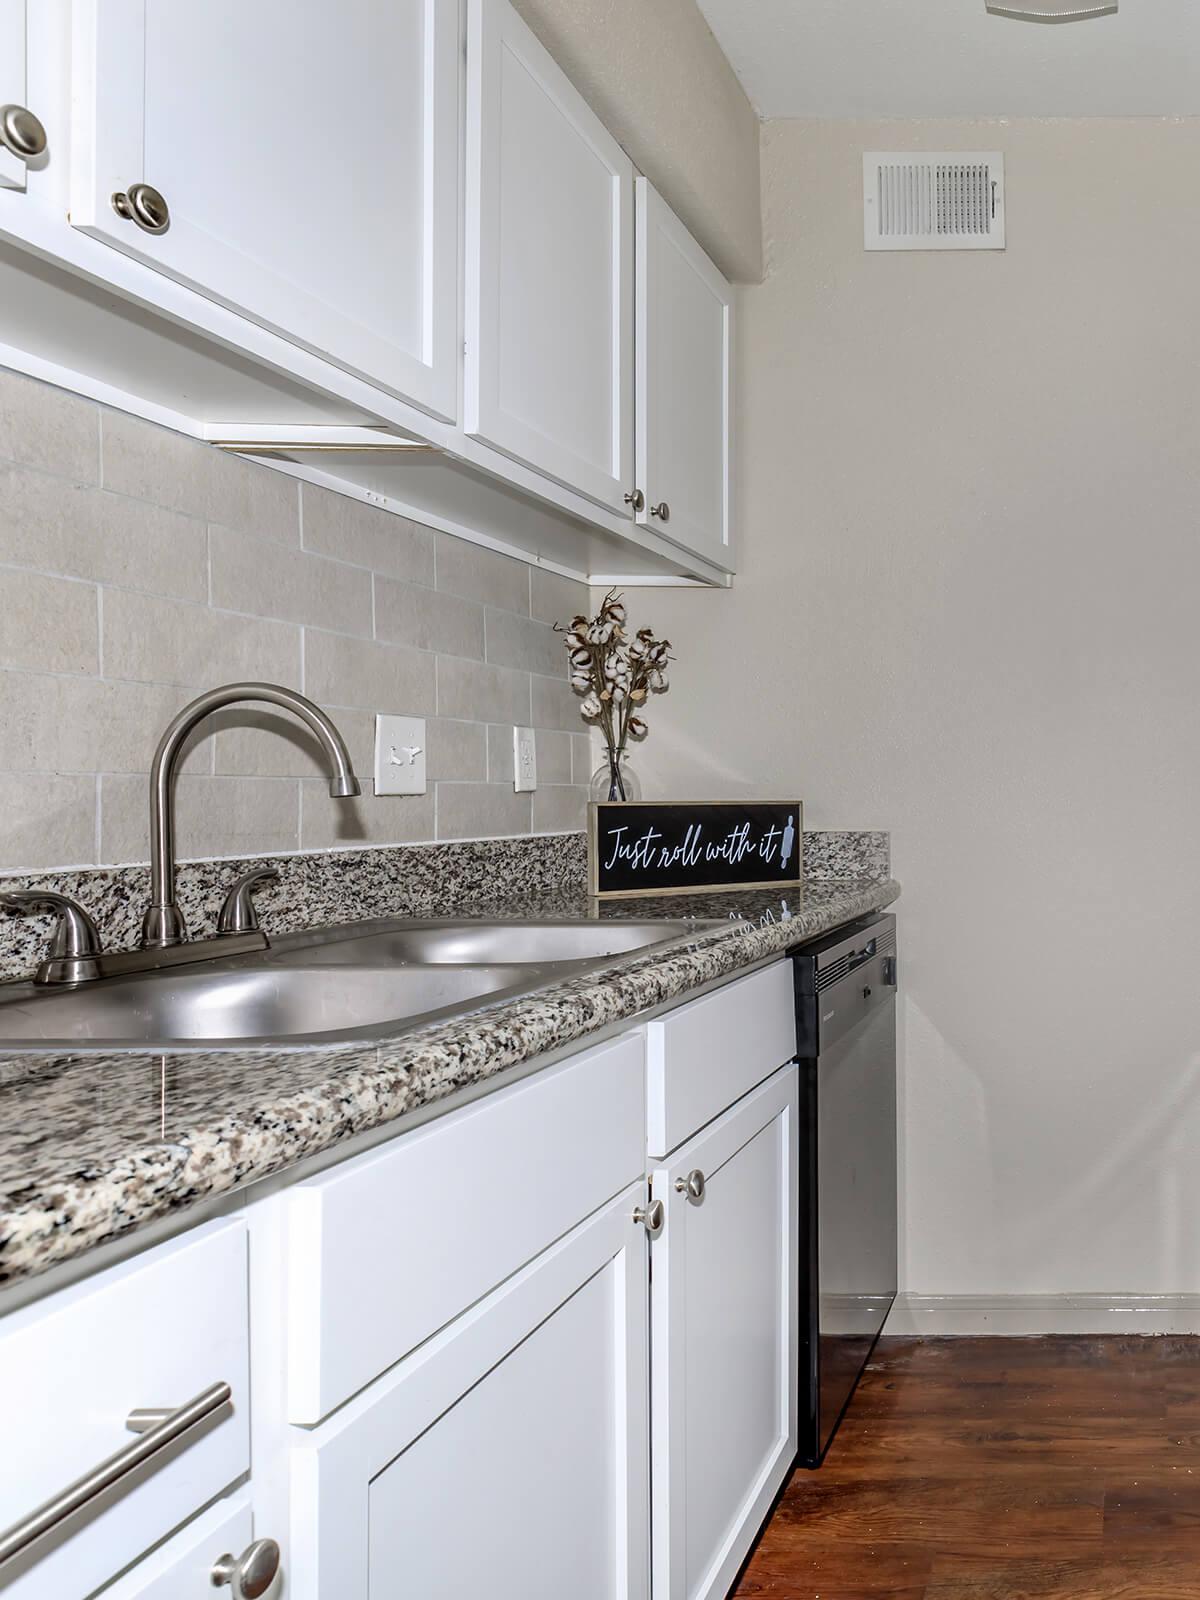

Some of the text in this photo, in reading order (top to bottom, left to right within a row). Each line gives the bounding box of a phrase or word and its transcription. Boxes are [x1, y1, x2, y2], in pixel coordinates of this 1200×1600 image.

[604, 822, 782, 870] Just roll with it
